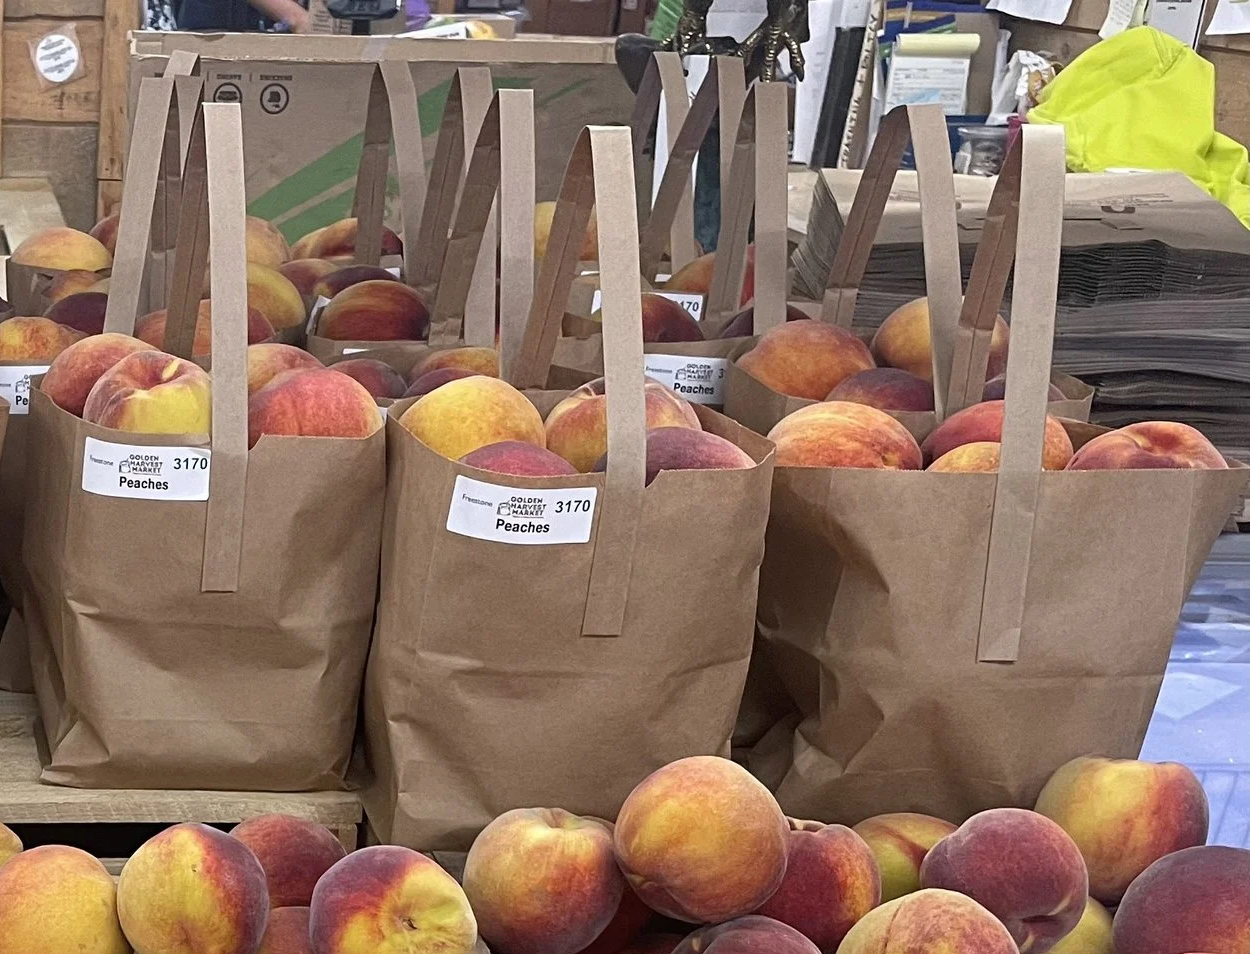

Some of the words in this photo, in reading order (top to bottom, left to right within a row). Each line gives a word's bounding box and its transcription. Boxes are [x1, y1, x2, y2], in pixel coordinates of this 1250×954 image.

[673, 382, 715, 395] Peaches
[130, 460, 164, 468] HARVEST
[173, 457, 208, 470] 3170
[119, 476, 169, 490] Peaches
[510, 496, 544, 504] GOLDEN
[555, 499, 591, 513] 3170
[495, 518, 550, 533] Peaches
